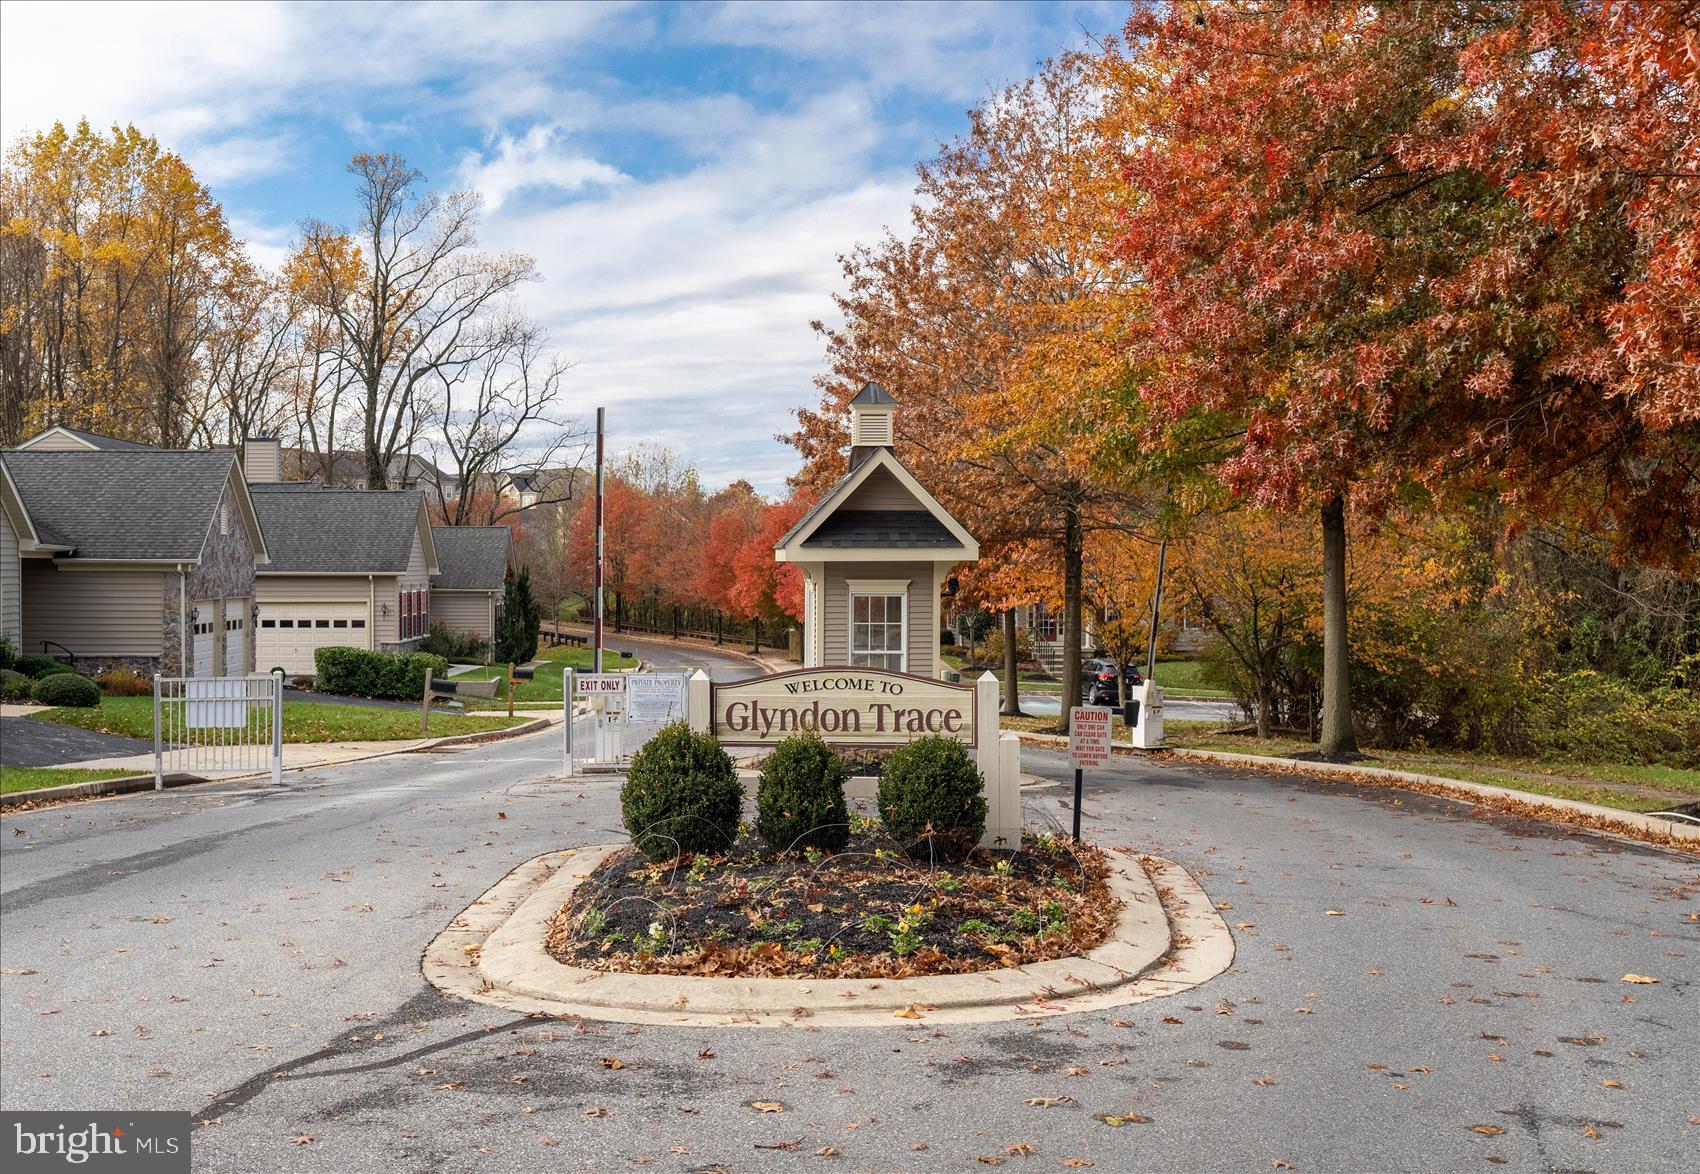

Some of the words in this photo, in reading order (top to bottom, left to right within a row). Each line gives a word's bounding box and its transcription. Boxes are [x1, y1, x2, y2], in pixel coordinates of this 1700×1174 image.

[580, 680, 597, 691] EXIT
[601, 680, 620, 691] ONLY
[784, 678, 874, 695] WELCOME
[879, 680, 904, 696] TO
[725, 700, 862, 739] Glyndon
[868, 703, 963, 733] Trace
[1074, 711, 1109, 721] CAUTION
